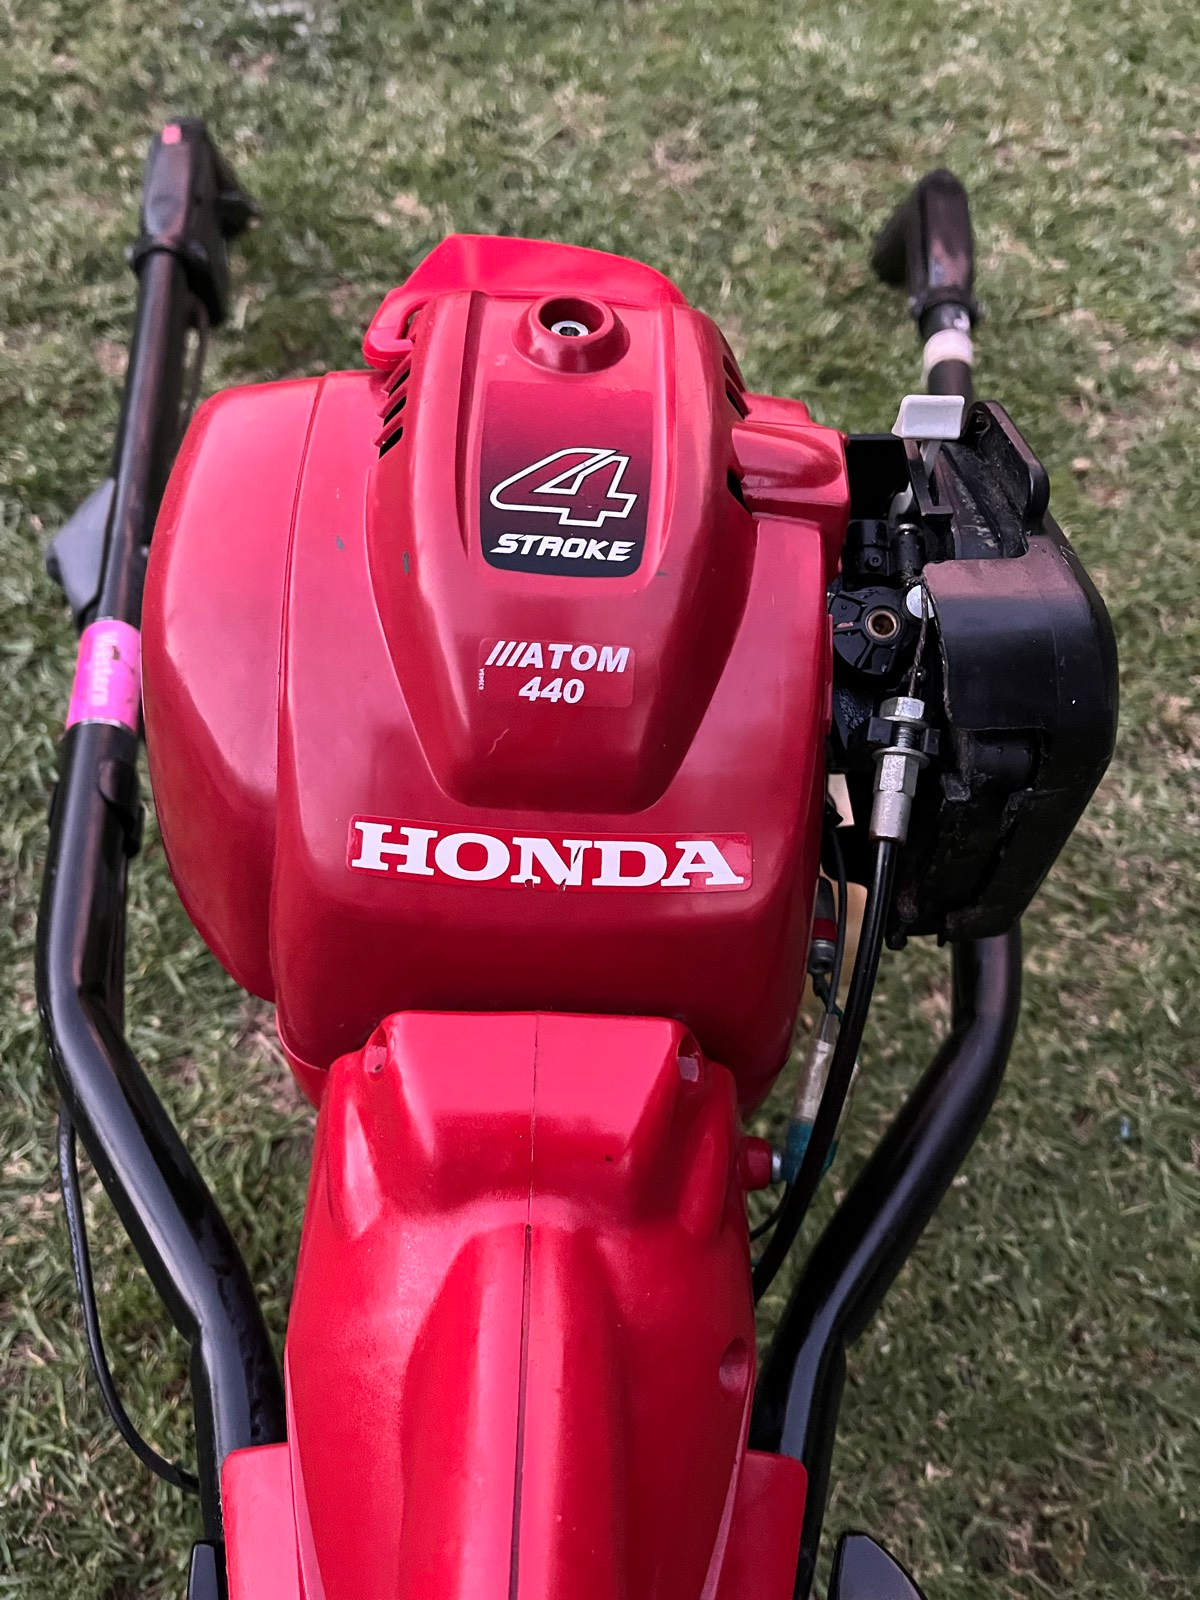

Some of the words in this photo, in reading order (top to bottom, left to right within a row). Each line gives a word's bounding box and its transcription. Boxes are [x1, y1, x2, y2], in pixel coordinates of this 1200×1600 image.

[489, 447, 638, 527] 4
[490, 533, 636, 562] STROKE
[518, 676, 585, 704] 440
[350, 820, 745, 888] HONDA
